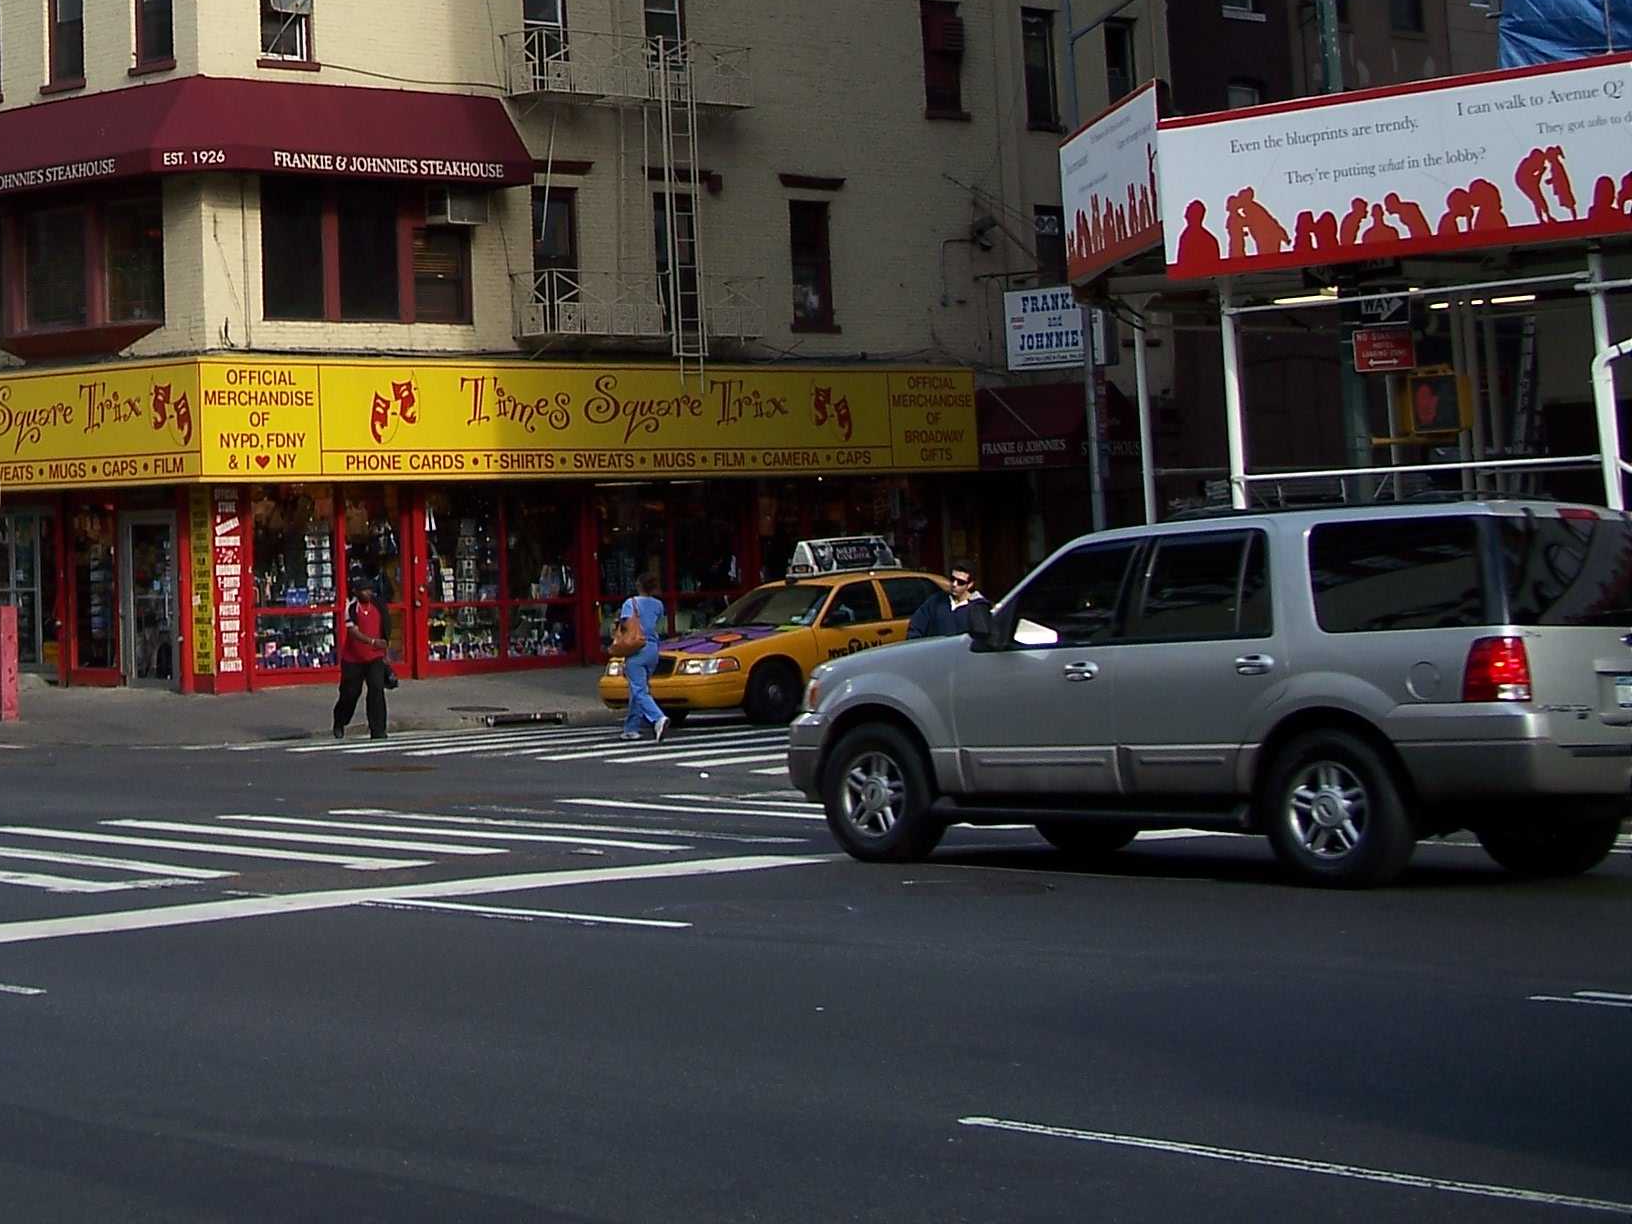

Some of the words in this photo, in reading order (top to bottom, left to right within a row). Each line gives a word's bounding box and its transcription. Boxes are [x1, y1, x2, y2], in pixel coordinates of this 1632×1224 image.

[1456, 101, 1463, 117] I
[1466, 102, 1491, 116] can
[1493, 94, 1527, 110] walk
[1529, 93, 1544, 106] to
[1547, 86, 1600, 105] Avenue
[1602, 79, 1625, 99] Q?
[1229, 138, 1261, 154] Even
[1263, 134, 1284, 150] the
[1285, 127, 1350, 147] blueprints
[1351, 124, 1372, 137] are
[1374, 115, 1420, 134] trendy.
[1535, 120, 1565, 136] They
[1566, 118, 1585, 134] got
[163, 152, 188, 166] EST.
[191, 150, 226, 165] 1926
[273, 151, 333, 170] FRANKIE
[336, 156, 347, 172] &
[419, 159, 505, 178] STEAKHOUSE
[1284, 168, 1332, 185] They're
[1333, 162, 1376, 182] putting
[1377, 156, 1405, 172] what
[1406, 155, 1420, 170] in
[1422, 151, 1444, 167] the
[1445, 145, 1487, 165] lobby?
[45, 158, 116, 183] STEAKHOUSE
[1021, 291, 1077, 314] FRANK
[1364, 296, 1394, 313] WAY
[1019, 329, 1085, 351] JOHNNIE'
[225, 368, 297, 386] OFFICIAL
[906, 375, 957, 391] OFFICIAL
[203, 389, 314, 407] MERCHANDISE
[891, 392, 973, 409] MERCHANDISE
[78, 381, 143, 435] Trix
[459, 375, 571, 434] Times
[583, 373, 704, 445] Square
[710, 378, 790, 427] Trix
[248, 411, 271, 428] OF
[925, 411, 942, 426] OF
[219, 432, 265, 451] NYPD,
[266, 432, 306, 449] FDNY
[904, 429, 965, 445] BROADWAY
[228, 454, 239, 470] &
[245, 454, 251, 470] I
[276, 453, 297, 469] NY
[345, 454, 402, 471] PHONE
[408, 453, 466, 470] CARDS
[483, 453, 555, 470] T-SHIRTS
[573, 452, 635, 469] SWEATS
[652, 451, 697, 468] MUGS
[713, 451, 746, 467] FILM
[761, 450, 819, 467] CAMERA
[835, 449, 872, 466] CAPS
[919, 447, 954, 463] GIFTS
[47, 461, 87, 481] MUGS
[101, 458, 139, 478] CAPS
[153, 456, 185, 475] FILM
